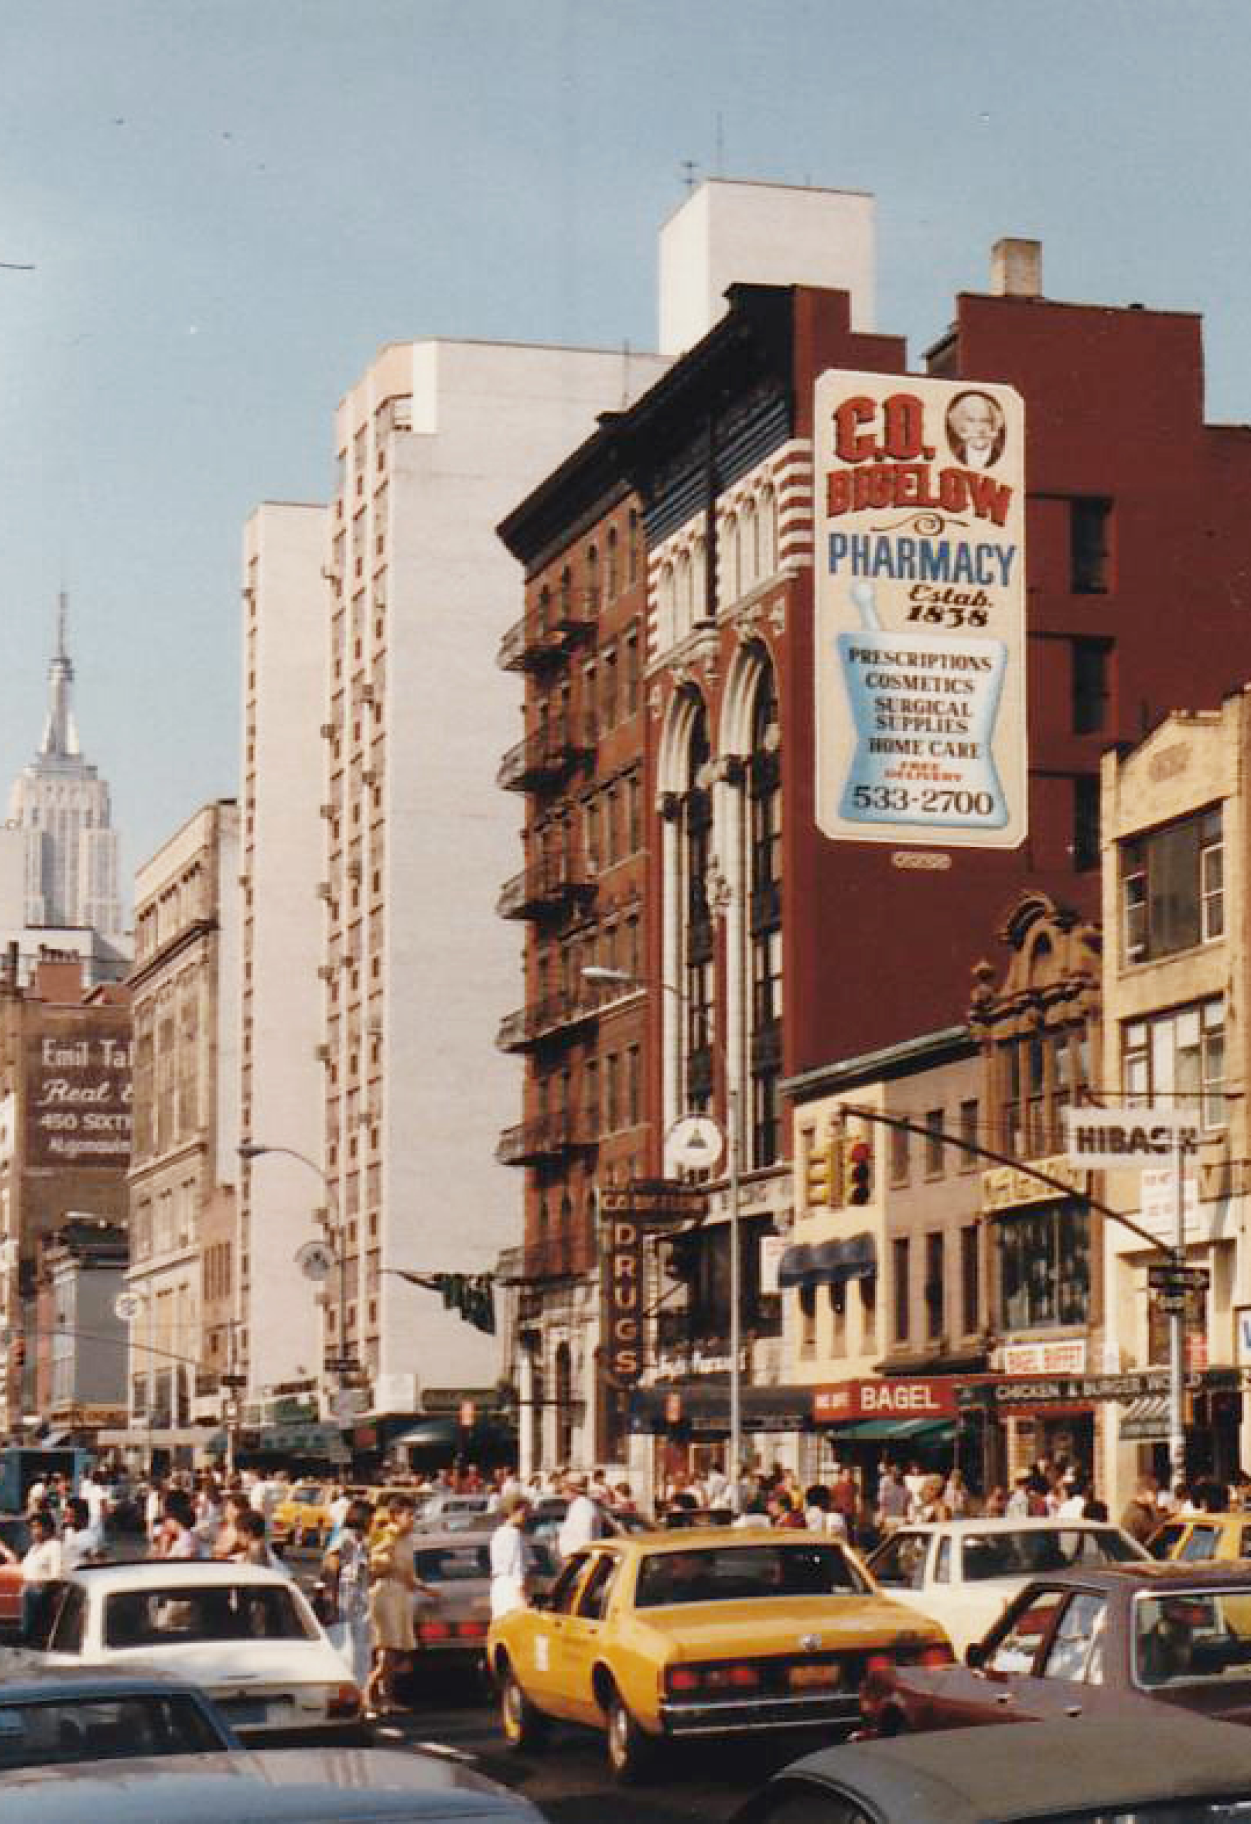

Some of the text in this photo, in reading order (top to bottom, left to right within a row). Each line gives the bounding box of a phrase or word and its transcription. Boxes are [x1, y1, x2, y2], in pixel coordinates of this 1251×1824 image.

[826, 463, 1013, 527] BIGELOW
[828, 532, 1018, 587] PHARMACY
[908, 584, 994, 608] Estab.
[905, 605, 989, 629] 1838
[850, 647, 993, 673] PRESCRIPTIONS
[865, 672, 976, 694] COSMETICS
[874, 695, 973, 717] SURGICAL
[876, 715, 969, 733] SUPPLIES
[867, 737, 980, 760] HOME CARE
[853, 785, 995, 816] 533-2700
[42, 1039, 88, 1067] Emil
[37, 1079, 110, 1106] Real
[41, 1113, 78, 1130] 450
[614, 1223, 637, 1374] DRUGS
[860, 1385, 941, 1411] BAGEL
[995, 1384, 1061, 1401] CHICKEN
